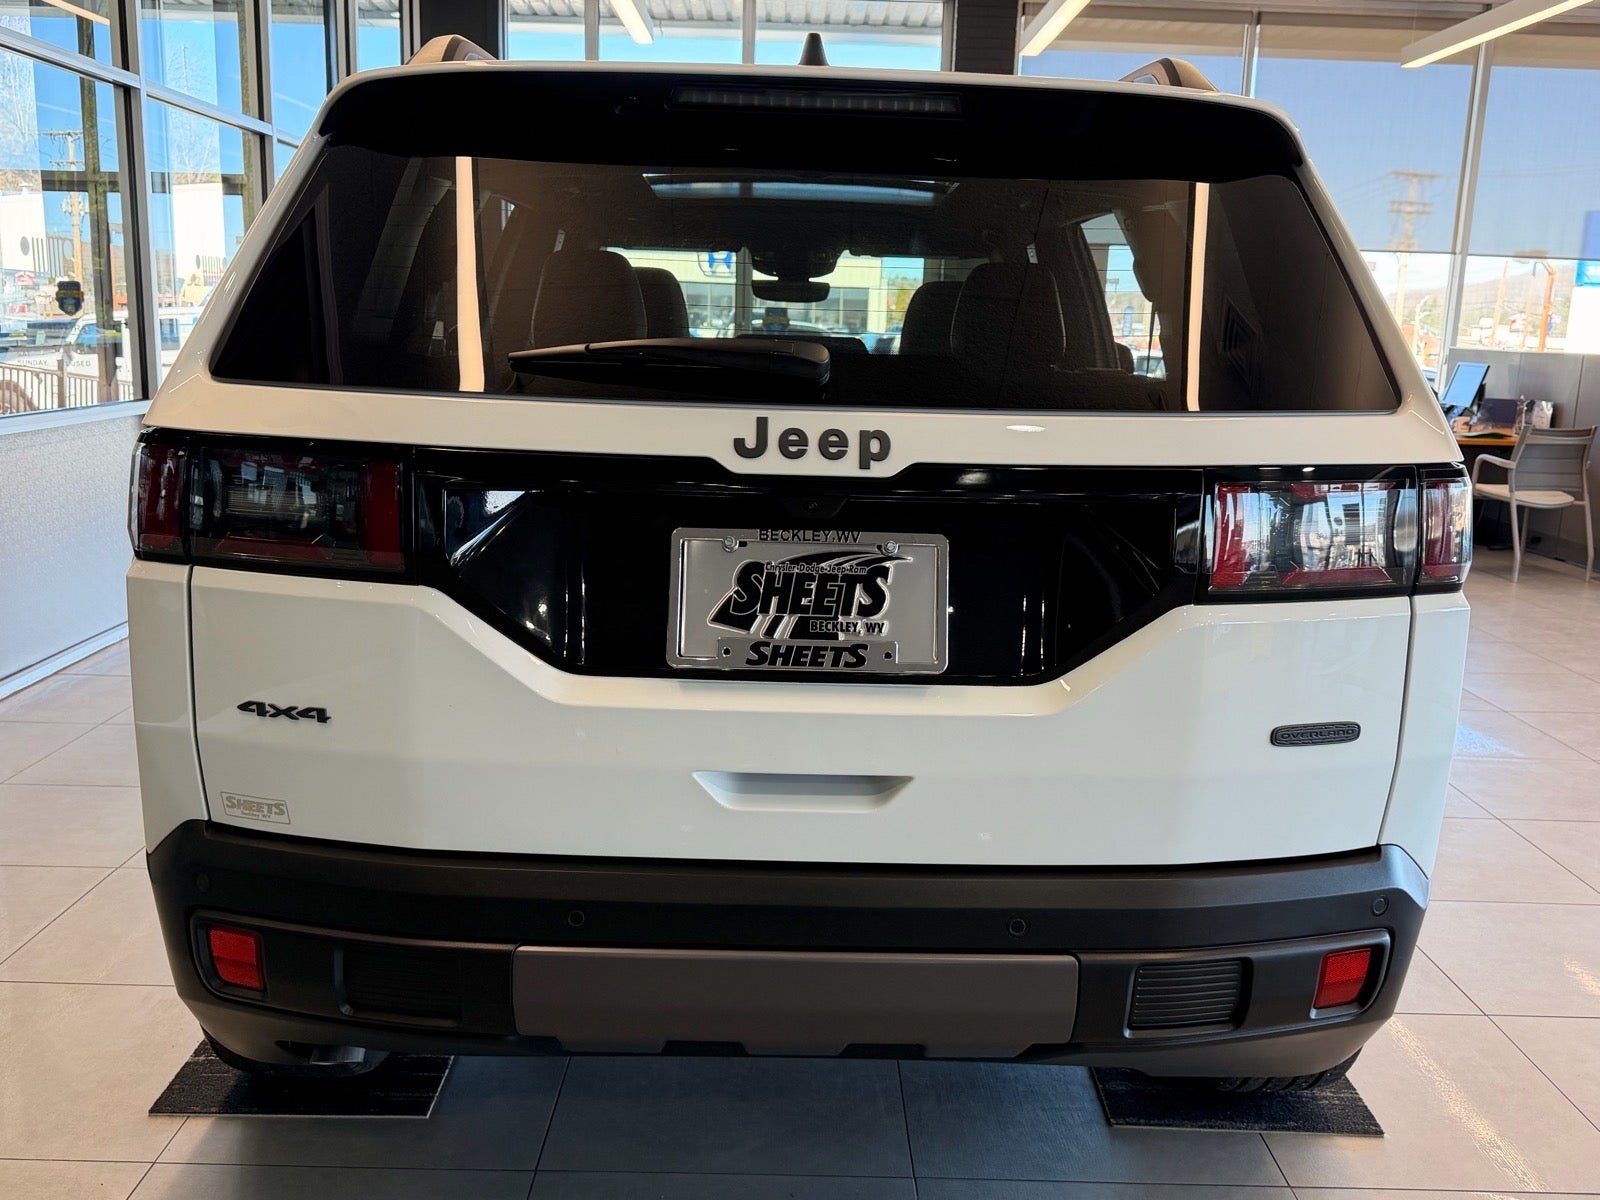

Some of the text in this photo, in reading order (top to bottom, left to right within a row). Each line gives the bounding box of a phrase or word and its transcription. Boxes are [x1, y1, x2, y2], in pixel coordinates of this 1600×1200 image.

[733, 416, 891, 470] Jeep
[730, 560, 892, 619] SHEETS
[865, 621, 886, 634] WV
[745, 641, 869, 669] SHEETS
[1280, 728, 1354, 740] OVERLAND
[225, 795, 286, 816] SHEETS
